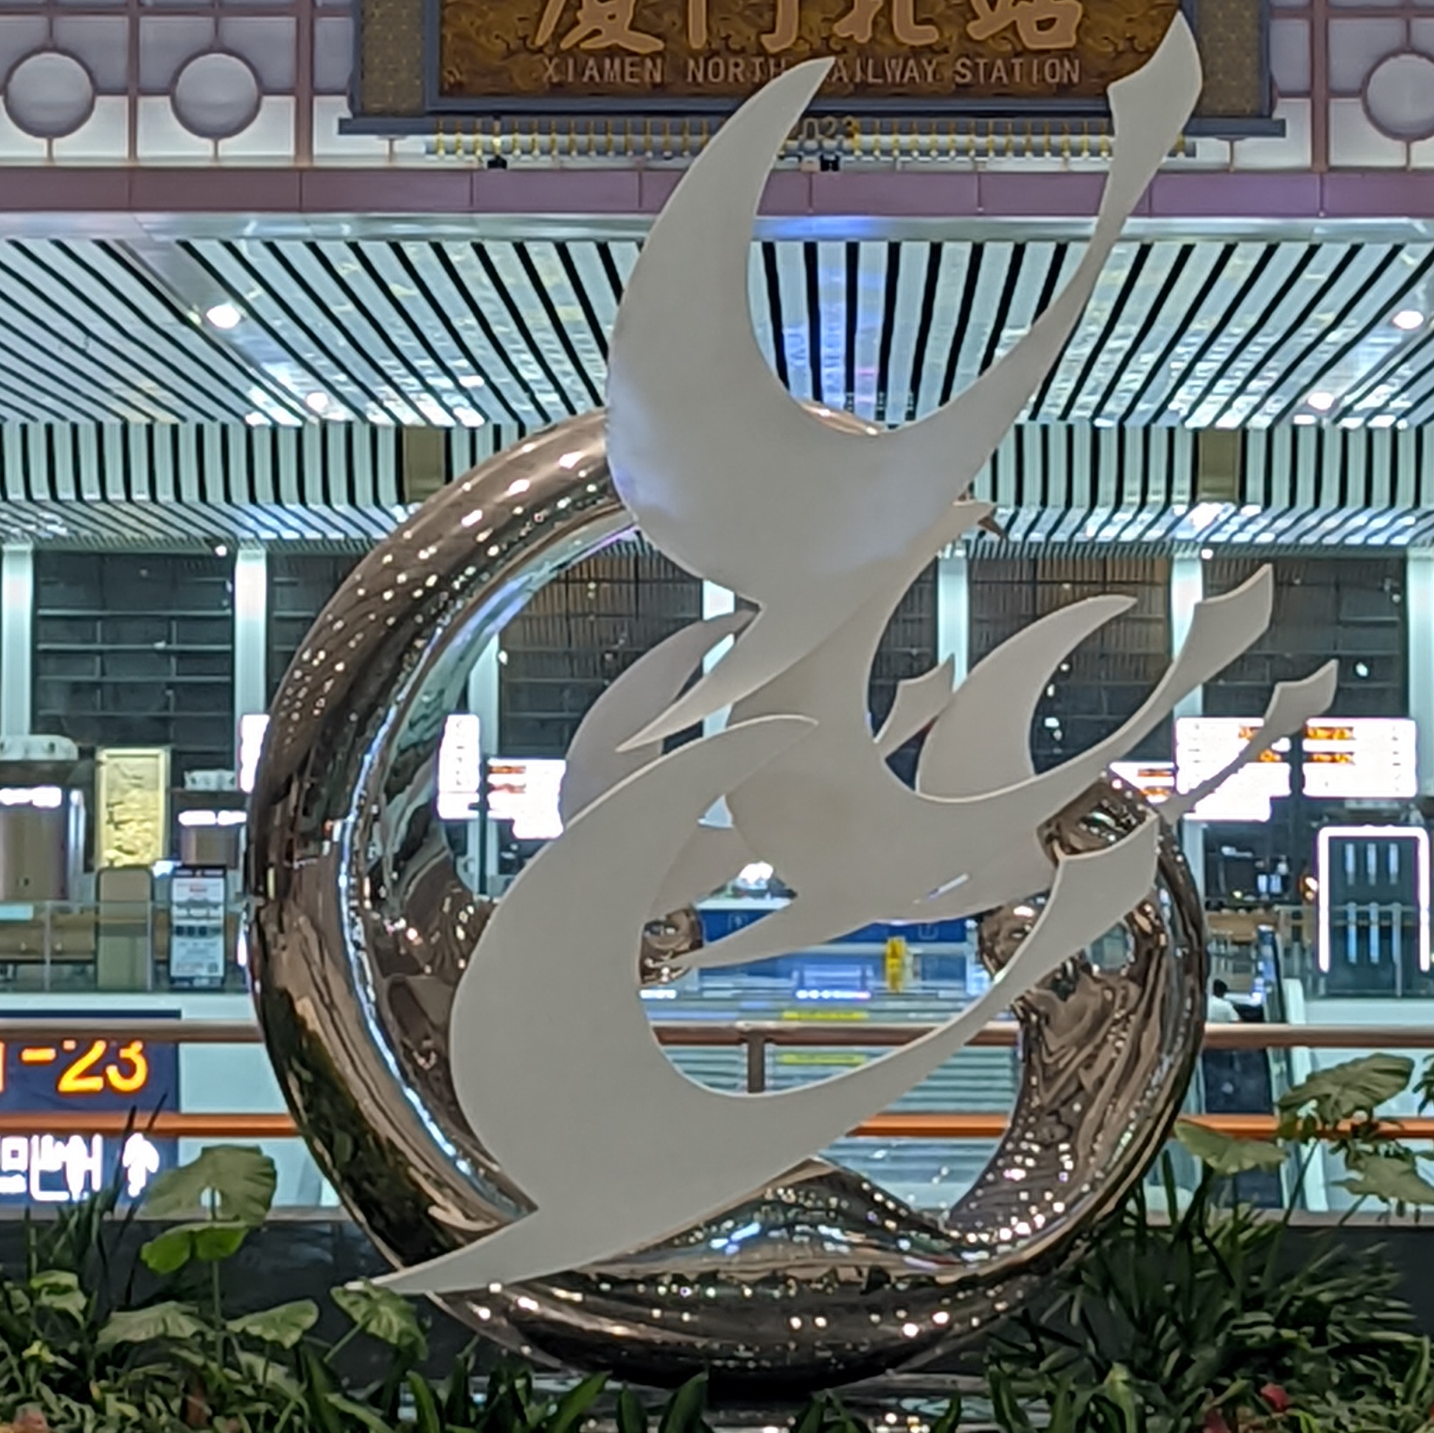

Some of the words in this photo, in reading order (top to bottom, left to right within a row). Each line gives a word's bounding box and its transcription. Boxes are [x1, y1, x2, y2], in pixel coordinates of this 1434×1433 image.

[542, 57, 664, 83] XIAMEN
[686, 57, 787, 83] NORTH
[825, 58, 938, 84] AILWAY
[954, 58, 1081, 84] STATION
